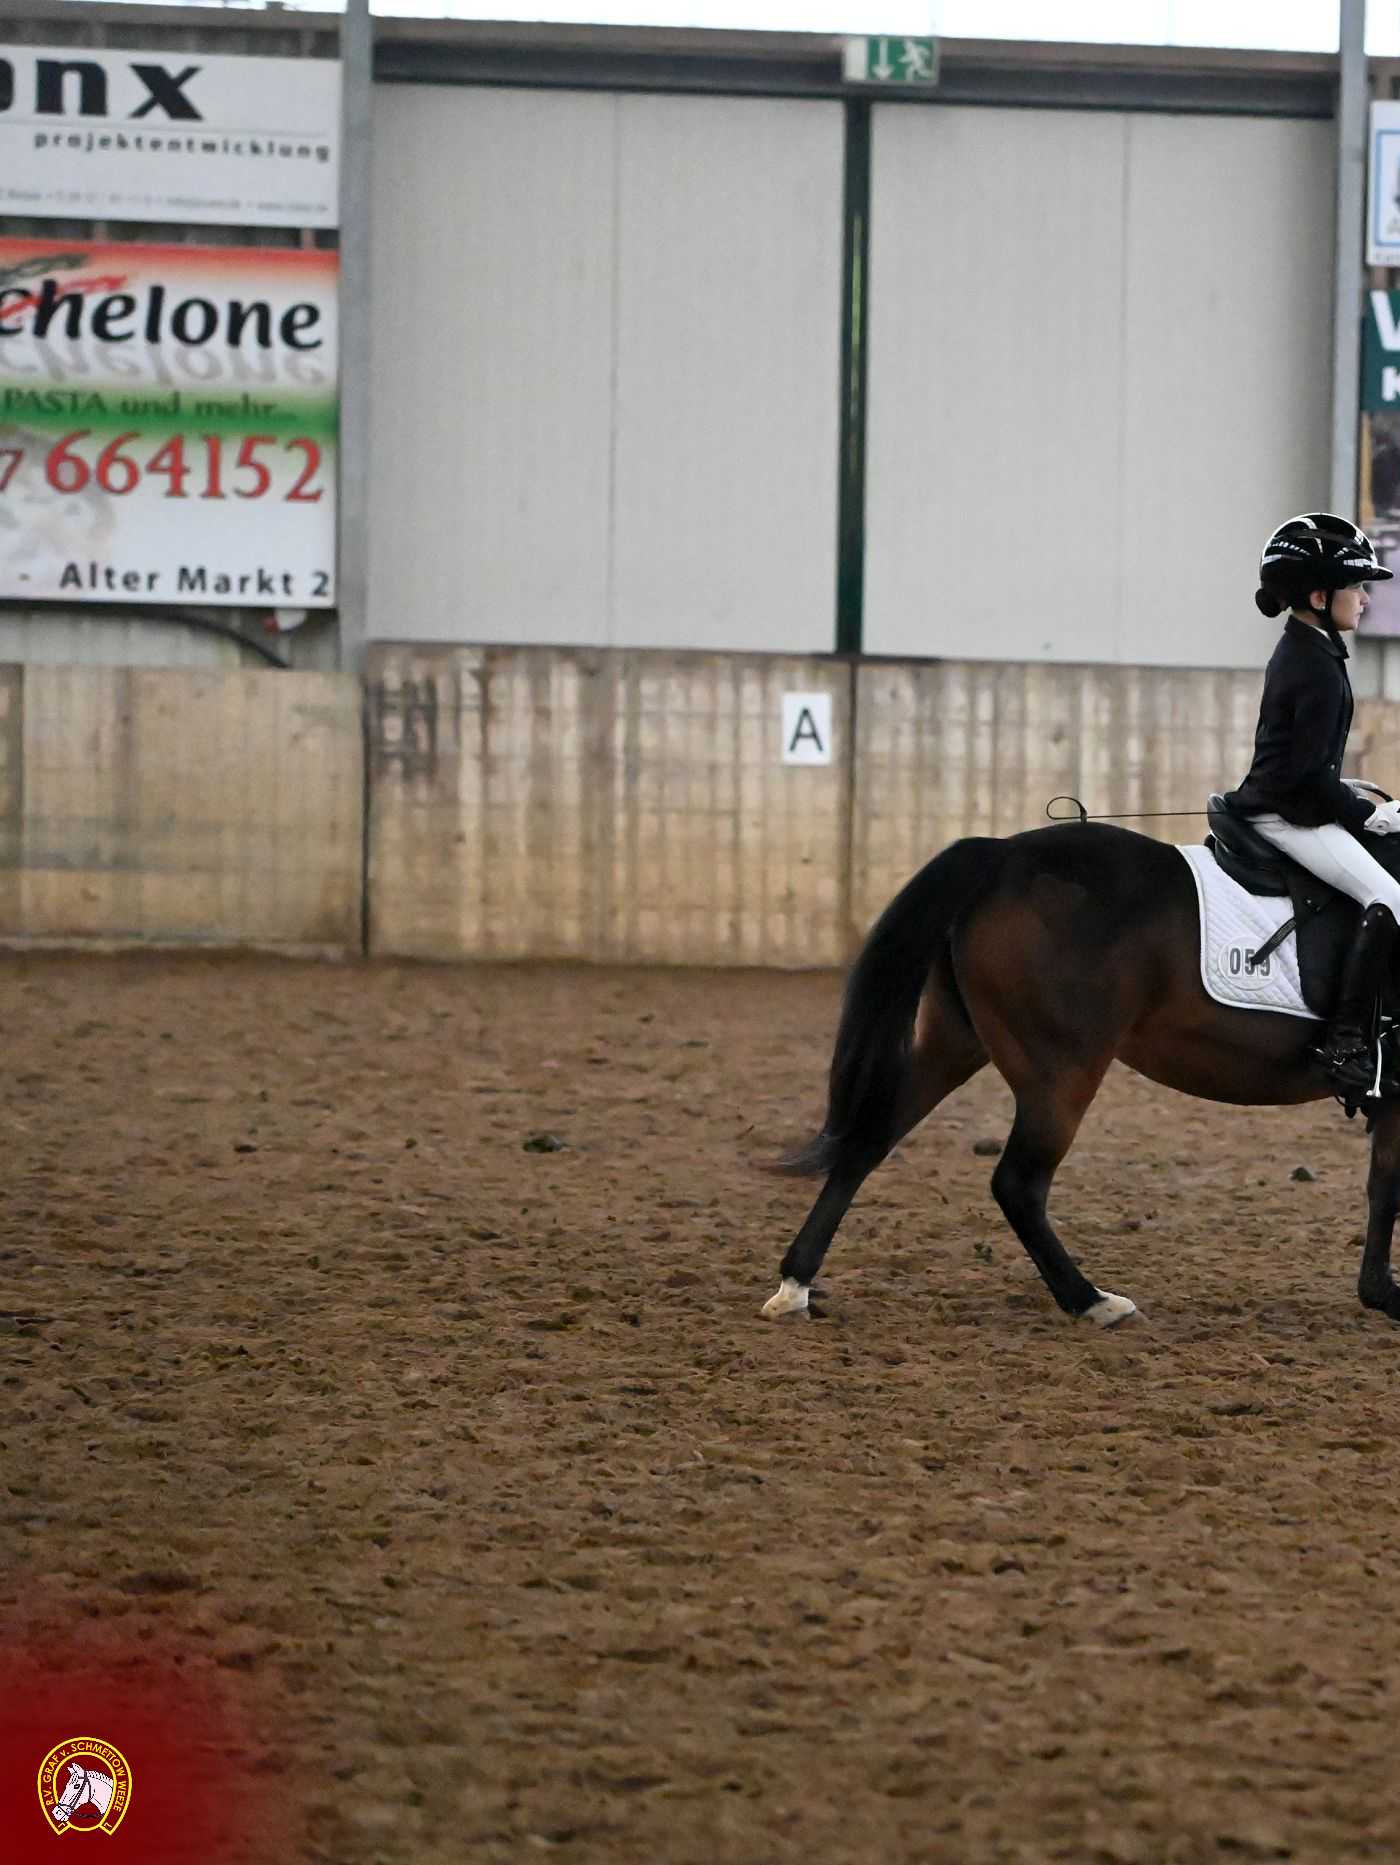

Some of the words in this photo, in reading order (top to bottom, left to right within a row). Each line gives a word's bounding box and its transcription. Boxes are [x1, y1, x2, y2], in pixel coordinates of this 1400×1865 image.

[0, 57, 204, 121] nx
[34, 131, 329, 162] projektentwicklung
[4, 388, 107, 415] PASTA
[120, 389, 181, 417] und
[45, 429, 326, 504] 664152
[59, 562, 161, 591] Alter
[178, 567, 294, 596] Markt
[312, 571, 330, 597] 2
[789, 708, 824, 752] A
